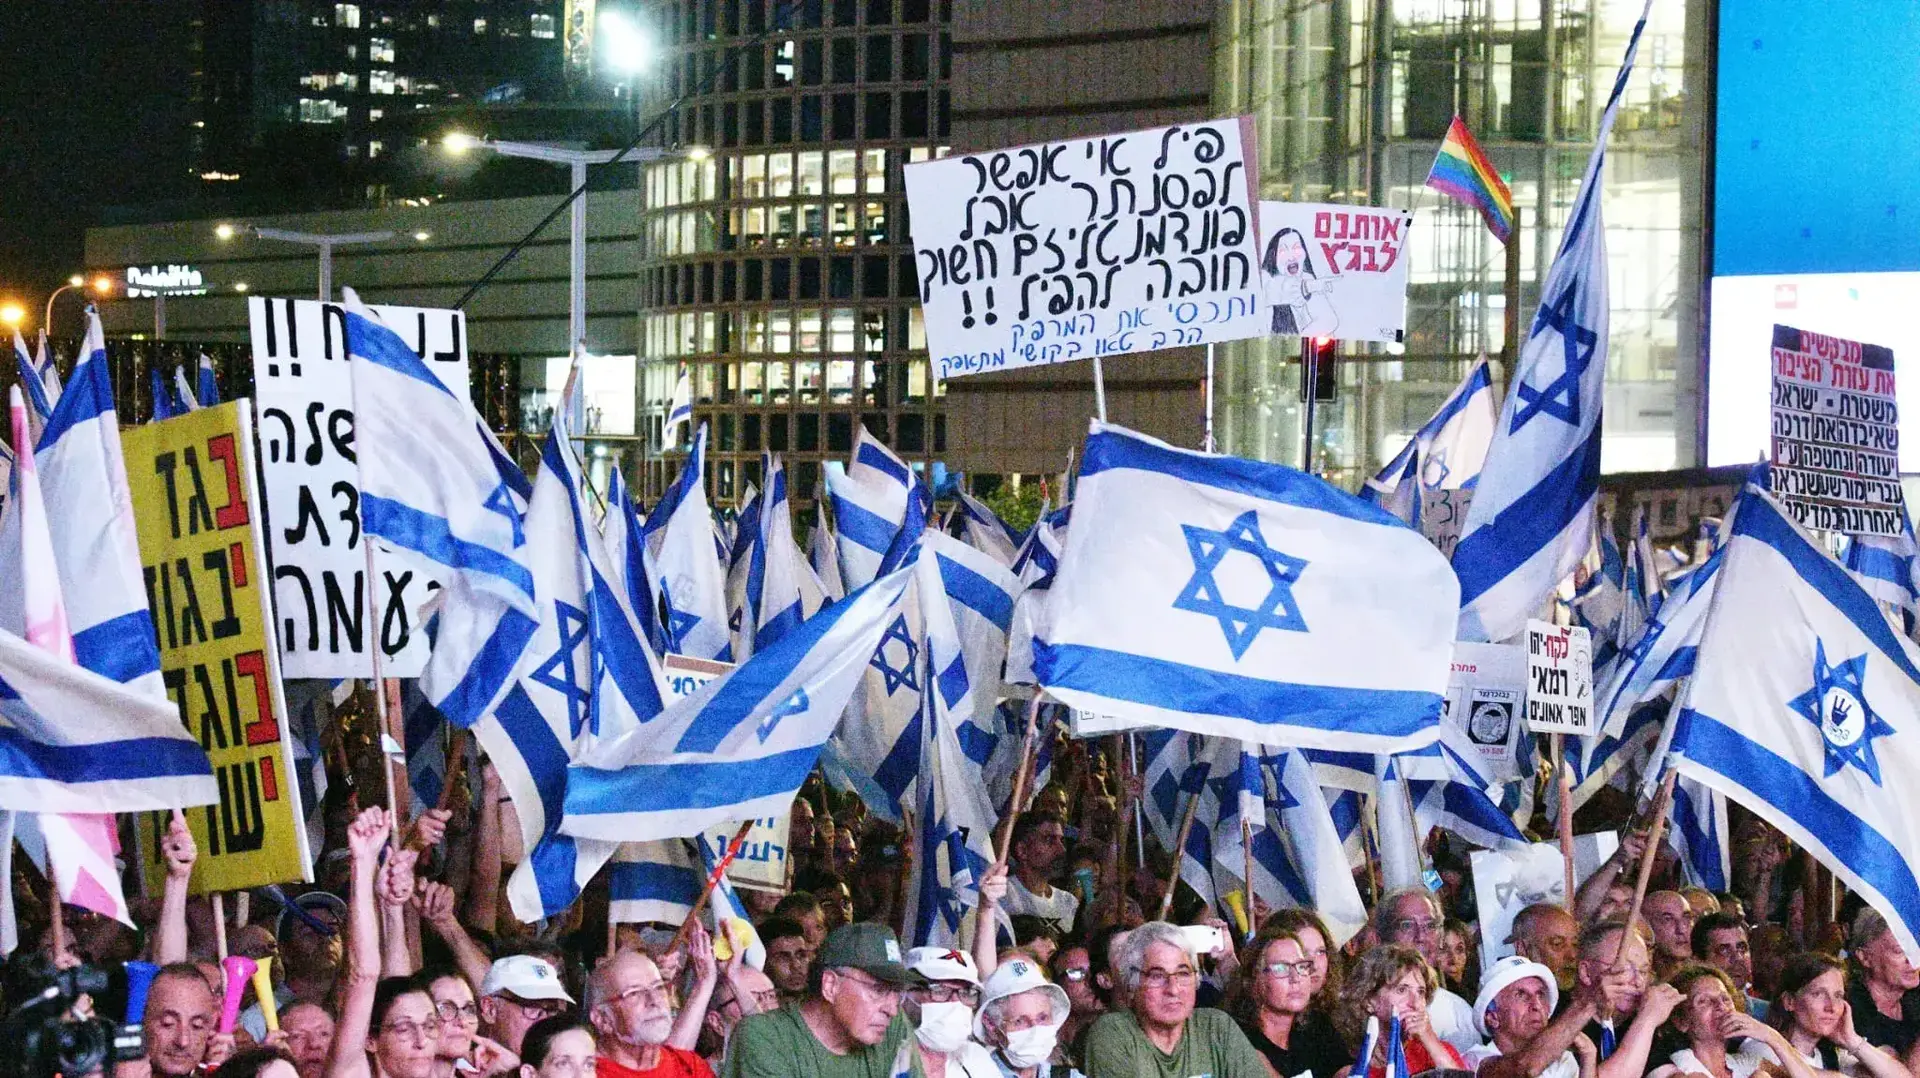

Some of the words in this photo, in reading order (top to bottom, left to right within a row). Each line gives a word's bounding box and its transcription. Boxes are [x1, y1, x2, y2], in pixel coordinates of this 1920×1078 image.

[1087, 138, 1131, 176] אי
[1154, 127, 1225, 170] פיל
[962, 145, 1071, 194] אפשר
[1071, 161, 1243, 222] לפסנתר
[959, 190, 1040, 241] אבל
[1314, 212, 1400, 241] אותכם
[919, 239, 998, 304] חשוך
[1146, 251, 1250, 302] חובה
[1018, 264, 1122, 321] להפיל
[323, 304, 460, 362] ננח
[1011, 314, 1095, 352] המרפק
[1117, 307, 1152, 332] את
[1151, 327, 1203, 349] הרב
[1800, 330, 1862, 364] מבקשים
[940, 346, 1006, 379] מתאפק
[1774, 350, 1822, 384] הציבור
[1831, 363, 1870, 392] עזרת
[1774, 376, 1818, 411] ישראל
[1875, 371, 1896, 396] את
[1774, 411, 1812, 440] דרכה
[1839, 394, 1898, 424] משטרת
[1814, 417, 1836, 442] את
[1838, 421, 1899, 450] שאיבדה
